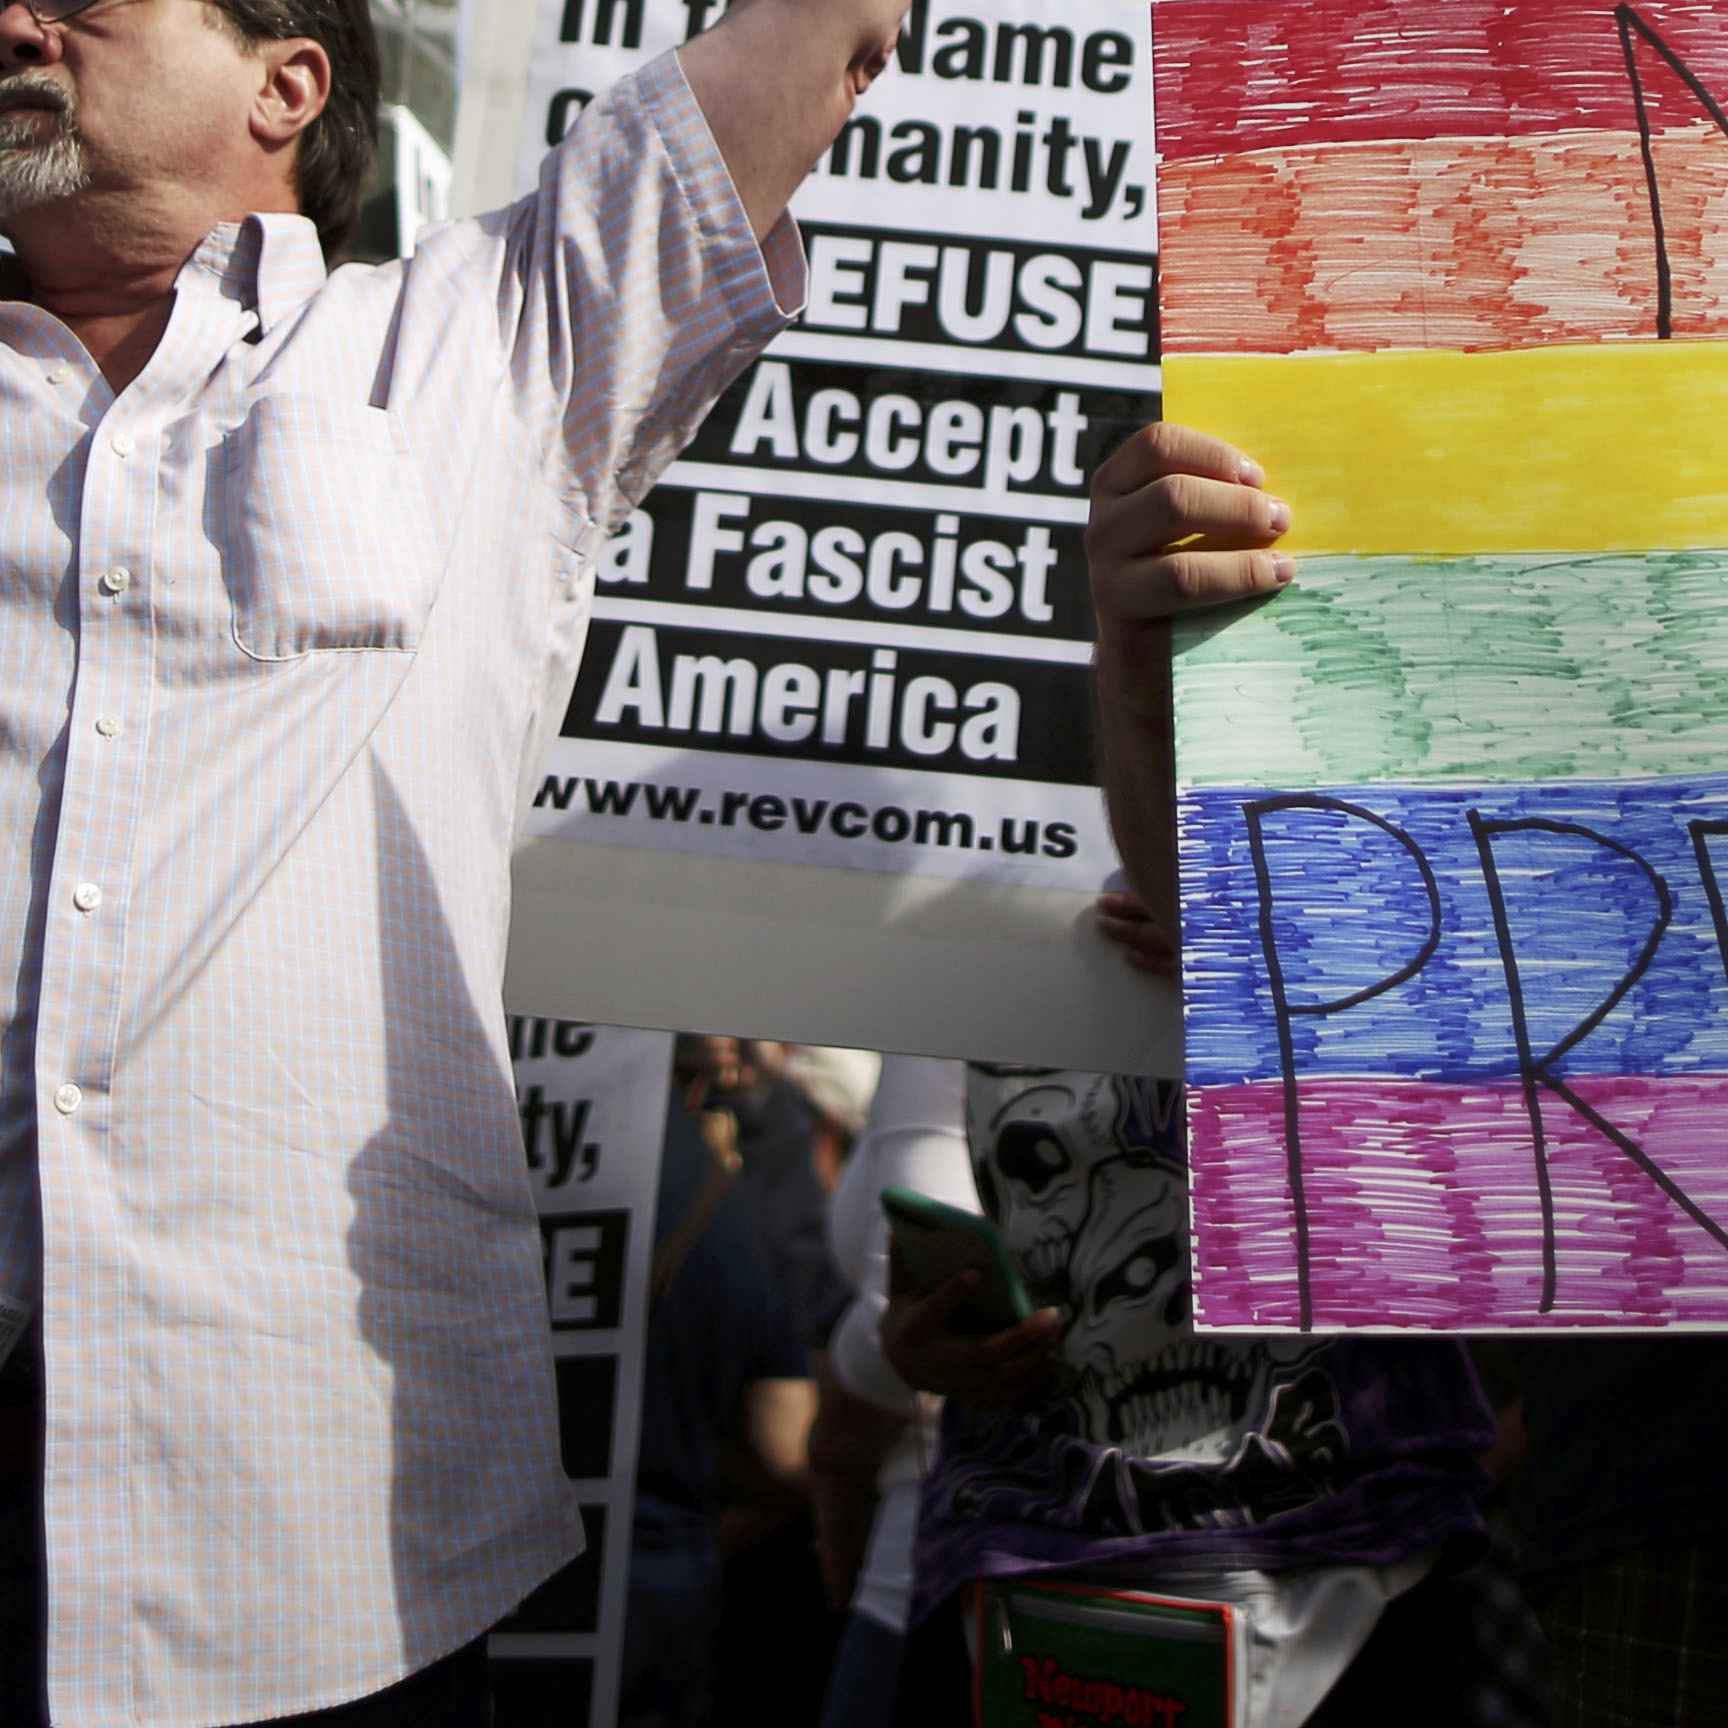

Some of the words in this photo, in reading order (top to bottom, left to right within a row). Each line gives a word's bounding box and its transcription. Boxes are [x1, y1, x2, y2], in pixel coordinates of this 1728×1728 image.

[813, 110, 1145, 222] manity,
[804, 234, 1154, 359] EFUSE
[729, 360, 1088, 494] Accept
[595, 507, 655, 585] a
[685, 492, 1058, 623] Fascist
[595, 625, 1022, 761] America
